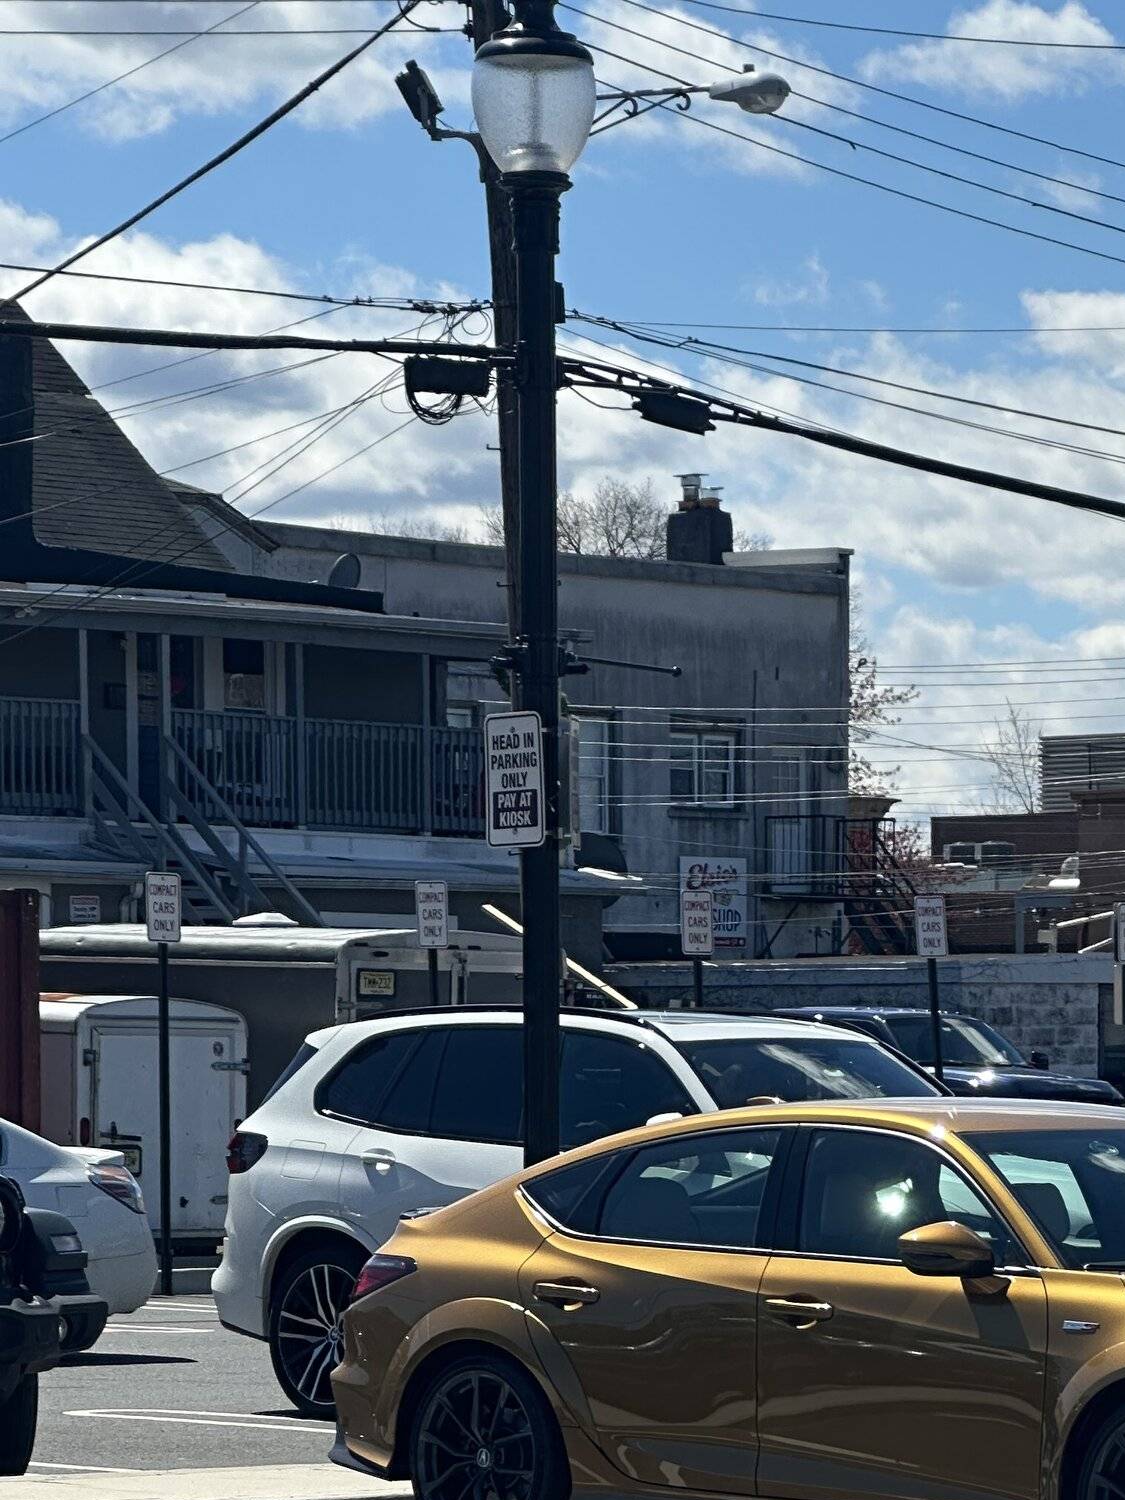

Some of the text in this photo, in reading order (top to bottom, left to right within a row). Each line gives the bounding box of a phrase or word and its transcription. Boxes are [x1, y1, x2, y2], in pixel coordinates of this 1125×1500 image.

[492, 732, 534, 750] HEAD IN
[490, 751, 538, 770] PARKING
[501, 771, 528, 788] ONLY
[497, 791, 533, 809] PAY AT
[499, 810, 532, 827] KIOSK
[149, 884, 177, 896] COMPACT
[153, 901, 175, 914] CARS
[684, 900, 710, 911] COMPACT
[422, 908, 443, 921] CARS
[154, 919, 175, 932] ONLY
[688, 916, 709, 928] CARS
[921, 922, 942, 933] CARS
[423, 925, 442, 938] ONLY
[688, 932, 708, 945] ONLY
[922, 937, 942, 949] ONLY
